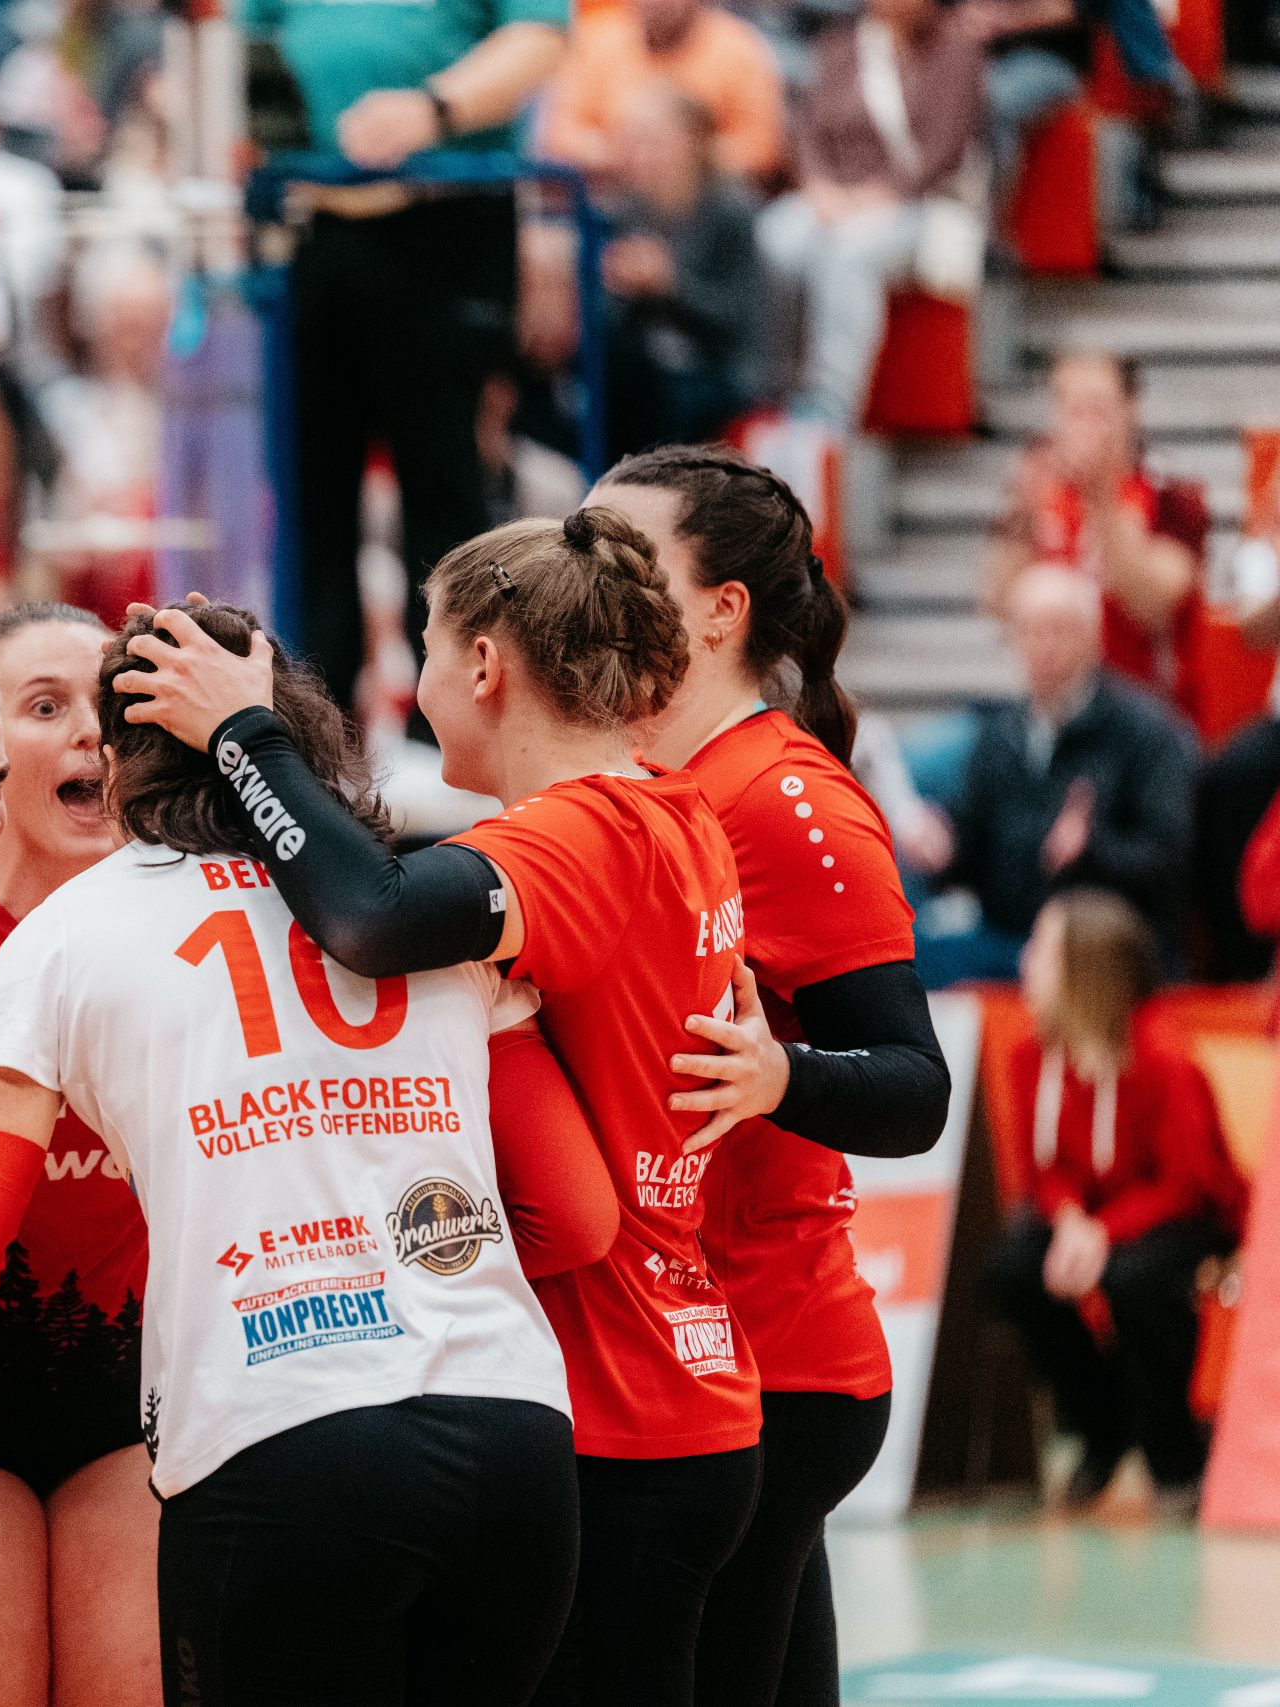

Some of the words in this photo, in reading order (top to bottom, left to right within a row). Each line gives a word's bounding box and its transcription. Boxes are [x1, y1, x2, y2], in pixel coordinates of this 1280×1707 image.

[216, 728, 307, 862] exware
[174, 909, 408, 1058] 10
[188, 1079, 317, 1136] BLACK
[320, 1077, 453, 1110] FOREST
[197, 1115, 315, 1160] VOLLEYS
[320, 1111, 462, 1136] OFFENBURG
[636, 1150, 713, 1184] BLACK
[404, 1184, 436, 1213] PREMIUM
[636, 1185, 697, 1209] VOLLEYS
[259, 1215, 370, 1253] E-WERK
[387, 1198, 502, 1263] Brauwerk
[265, 1239, 379, 1270] MITTELBADEN
[238, 1273, 383, 1313] AUTOLACKIERBETRIEB
[241, 1289, 390, 1349] KONPRECHT
[250, 1327, 399, 1365] UNFALLINSTANDSETZUNG
